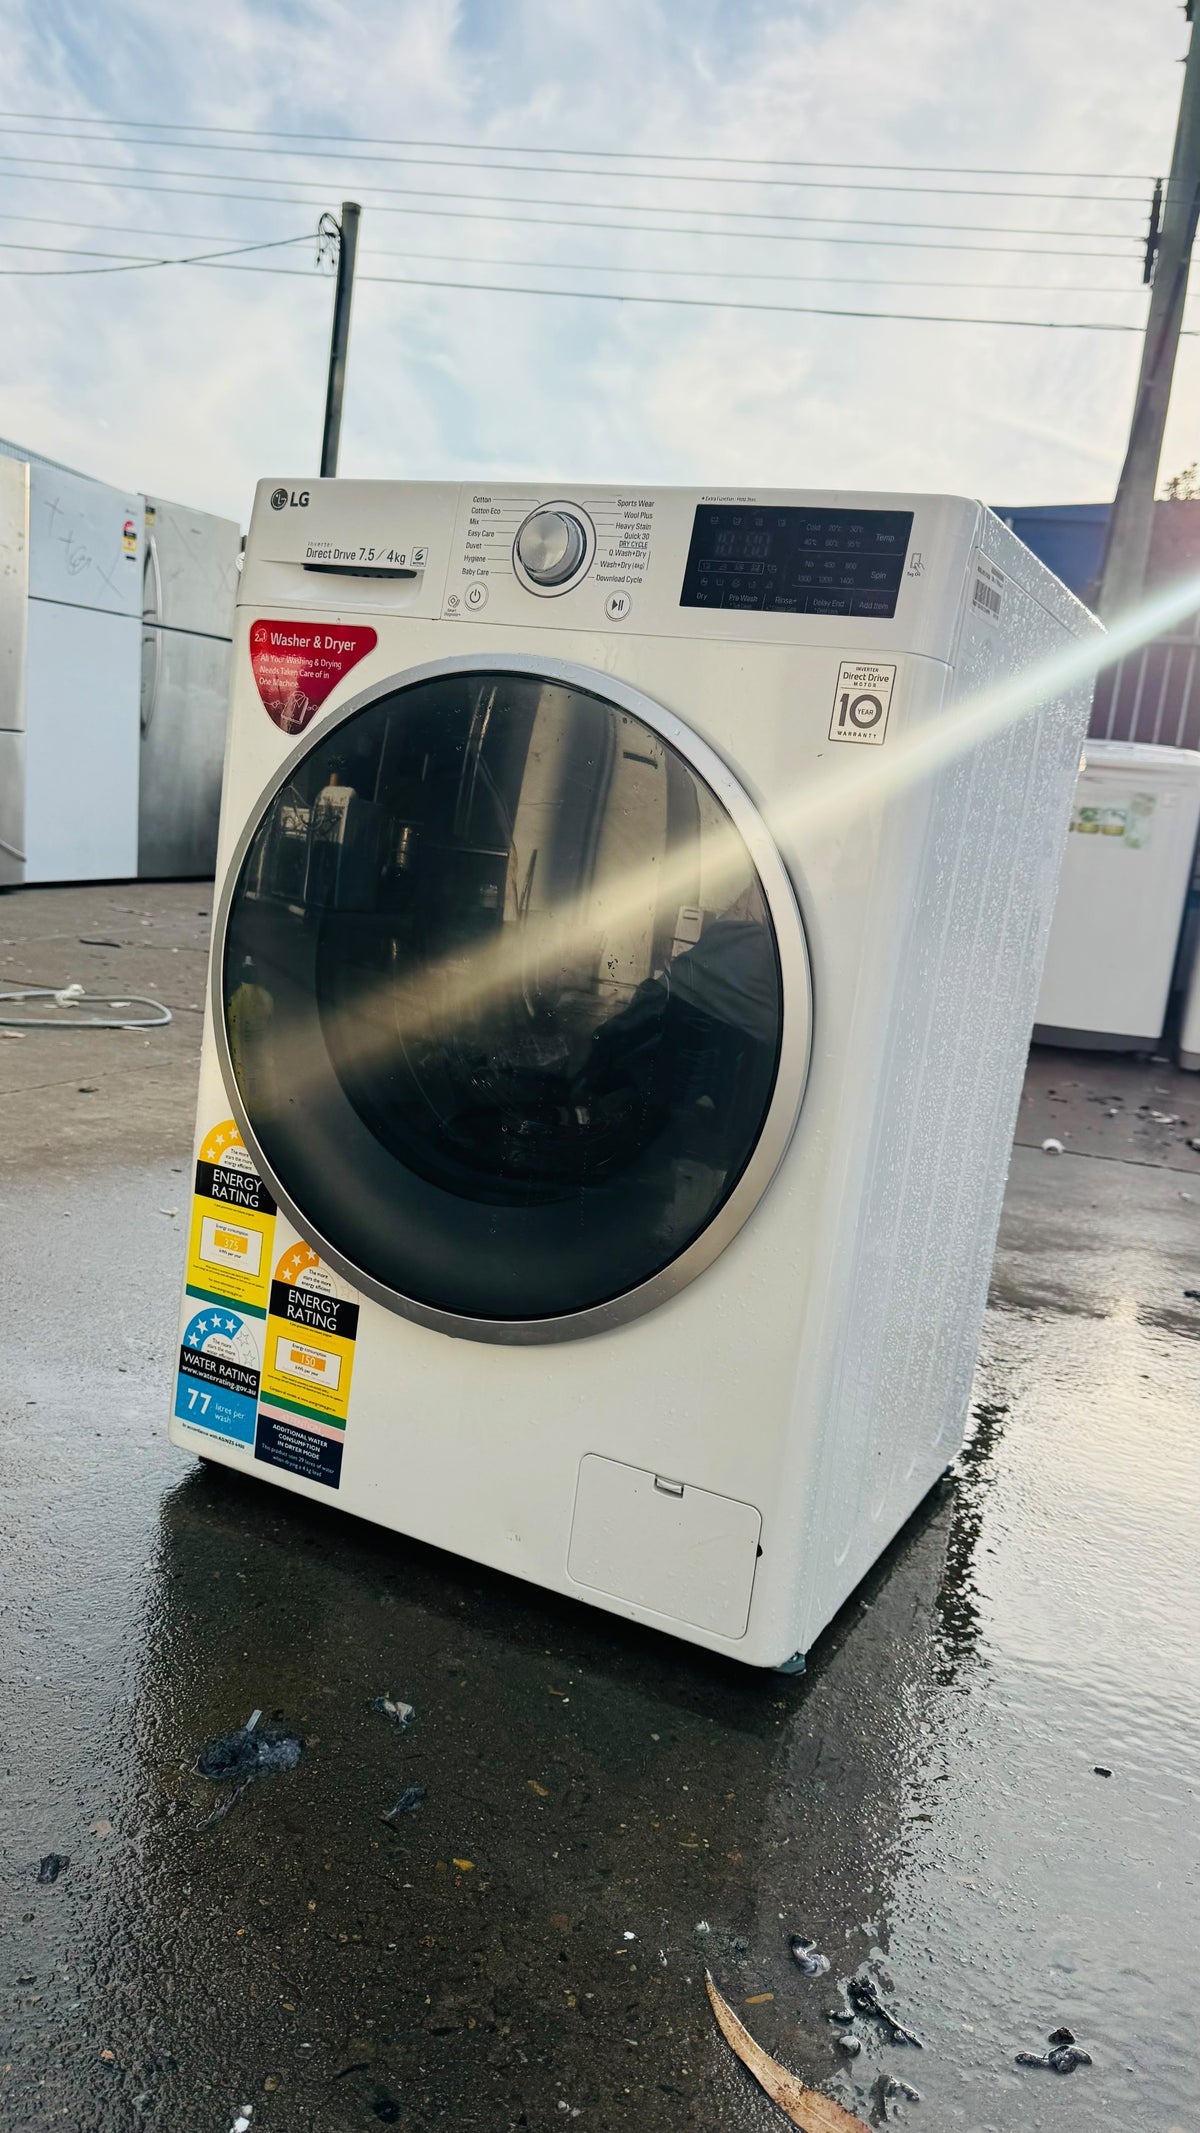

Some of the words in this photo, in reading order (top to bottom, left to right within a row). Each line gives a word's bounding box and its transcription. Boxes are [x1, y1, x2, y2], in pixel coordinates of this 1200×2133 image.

[290, 492, 310, 507] LG
[473, 496, 492, 504] Cotton
[617, 500, 638, 508] Sports
[638, 500, 655, 508] Wear
[471, 507, 490, 515] Cotton
[640, 512, 653, 520] Plus
[616, 523, 635, 531] Heavy
[636, 523, 652, 531] Stain
[468, 530, 481, 538] Easy
[482, 530, 495, 538] Care
[876, 534, 895, 543] Temp
[631, 541, 648, 549] CYCLE
[306, 547, 331, 560] Direct
[333, 549, 356, 561] Drive
[359, 548, 375, 561] 7.5
[386, 549, 406, 566] 4kg
[464, 555, 486, 563] Hygiene
[462, 568, 476, 576] Baby
[871, 571, 887, 581] Spin
[596, 574, 626, 583] Download
[626, 575, 643, 585] Cycle
[697, 592, 708, 601] Dry
[729, 594, 740, 602] Pre
[740, 594, 759, 603] Wash
[813, 598, 832, 608] Delay
[832, 600, 845, 608] End
[859, 601, 874, 609] Add
[874, 602, 889, 611] Item
[270, 632, 311, 648] Washer
[313, 635, 322, 648] &
[324, 637, 357, 654] Dryer
[261, 654, 270, 663] All
[270, 655, 285, 663] Your
[286, 656, 313, 668] Washing
[314, 659, 319, 667] &
[321, 659, 342, 671] Drying
[260, 666, 280, 675] Needs
[281, 667, 299, 677] Taken
[299, 670, 314, 678] Care
[315, 671, 324, 679] of
[843, 672, 867, 681] Direct
[868, 673, 890, 683] Drive
[259, 677, 272, 686] One
[839, 693, 883, 729] 10
[838, 731, 877, 739] WARRANTY
[213, 1169, 262, 1193] ENERGY
[212, 1184, 260, 1208] RATING
[224, 1238, 239, 1251] 375
[301, 1281, 315, 1289] energy
[288, 1289, 340, 1316] ENERGY
[287, 1304, 338, 1331] RATING
[213, 1337, 221, 1345] The
[221, 1341, 232, 1349] more
[207, 1349, 218, 1357] water
[301, 1354, 316, 1368] 150
[184, 1351, 217, 1373] WATER
[219, 1365, 258, 1387] RATING
[182, 1364, 257, 1396] www.waterrating.gov.au
[187, 1387, 212, 1415] 77
[215, 1403, 232, 1416] litres
[233, 1409, 245, 1420] per
[215, 1413, 232, 1424] wash
[273, 1424, 308, 1441] ADDITIONAL
[308, 1436, 328, 1448] WATER
[278, 1433, 321, 1453] CONSUMPTION
[271, 1447, 288, 1457] product
[284, 1443, 303, 1454] DRYER
[303, 1450, 320, 1460] MODE
